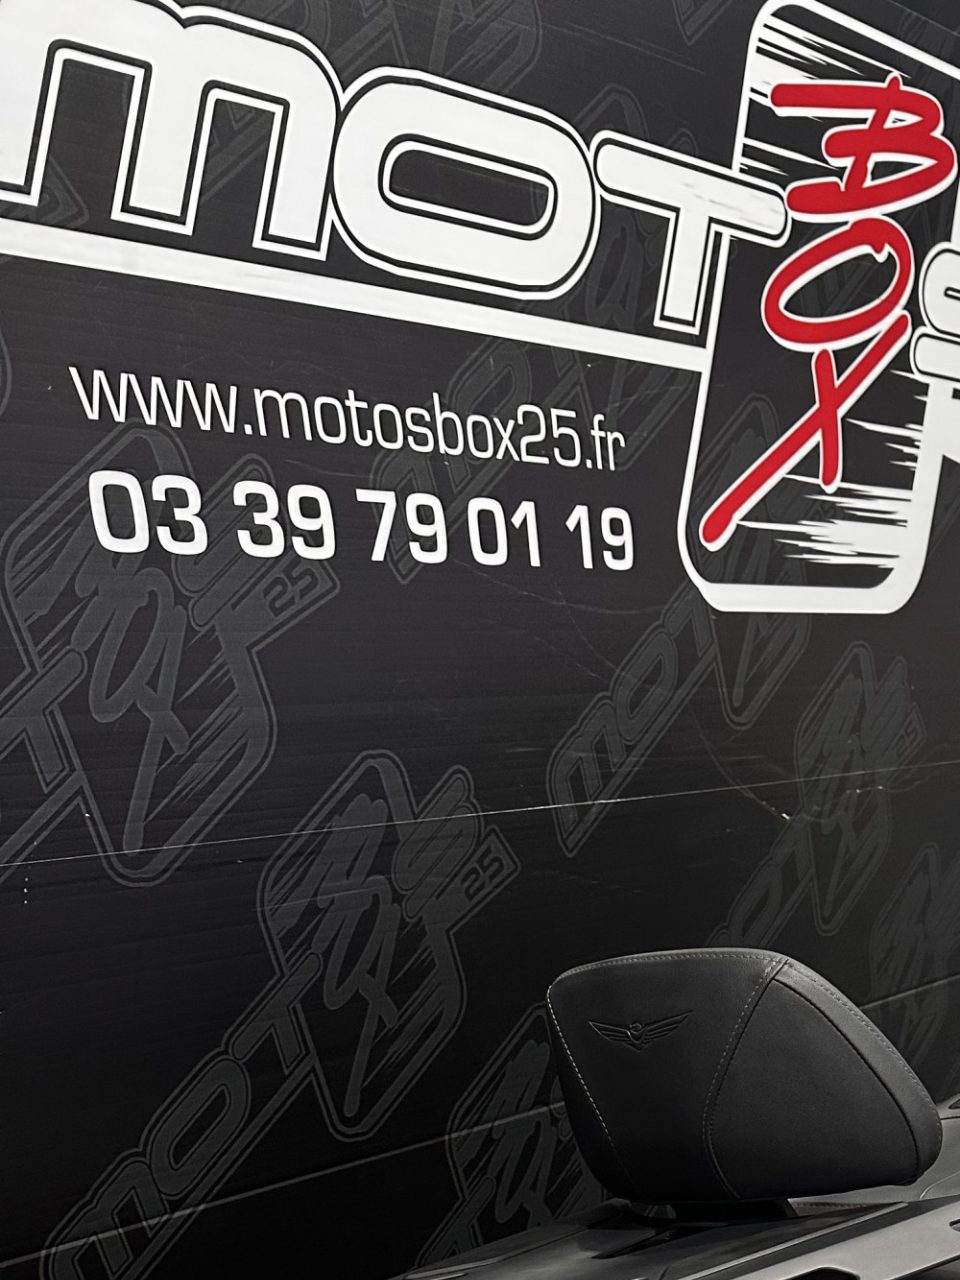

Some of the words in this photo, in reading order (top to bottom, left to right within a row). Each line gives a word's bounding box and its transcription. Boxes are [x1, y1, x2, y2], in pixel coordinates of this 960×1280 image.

[69, 366, 626, 471] www.motosbox25.fr
[88, 470, 208, 555] 03
[232, 481, 336, 560] 39
[356, 489, 448, 565] 79
[467, 497, 541, 567] 01
[565, 504, 634, 571] 19
